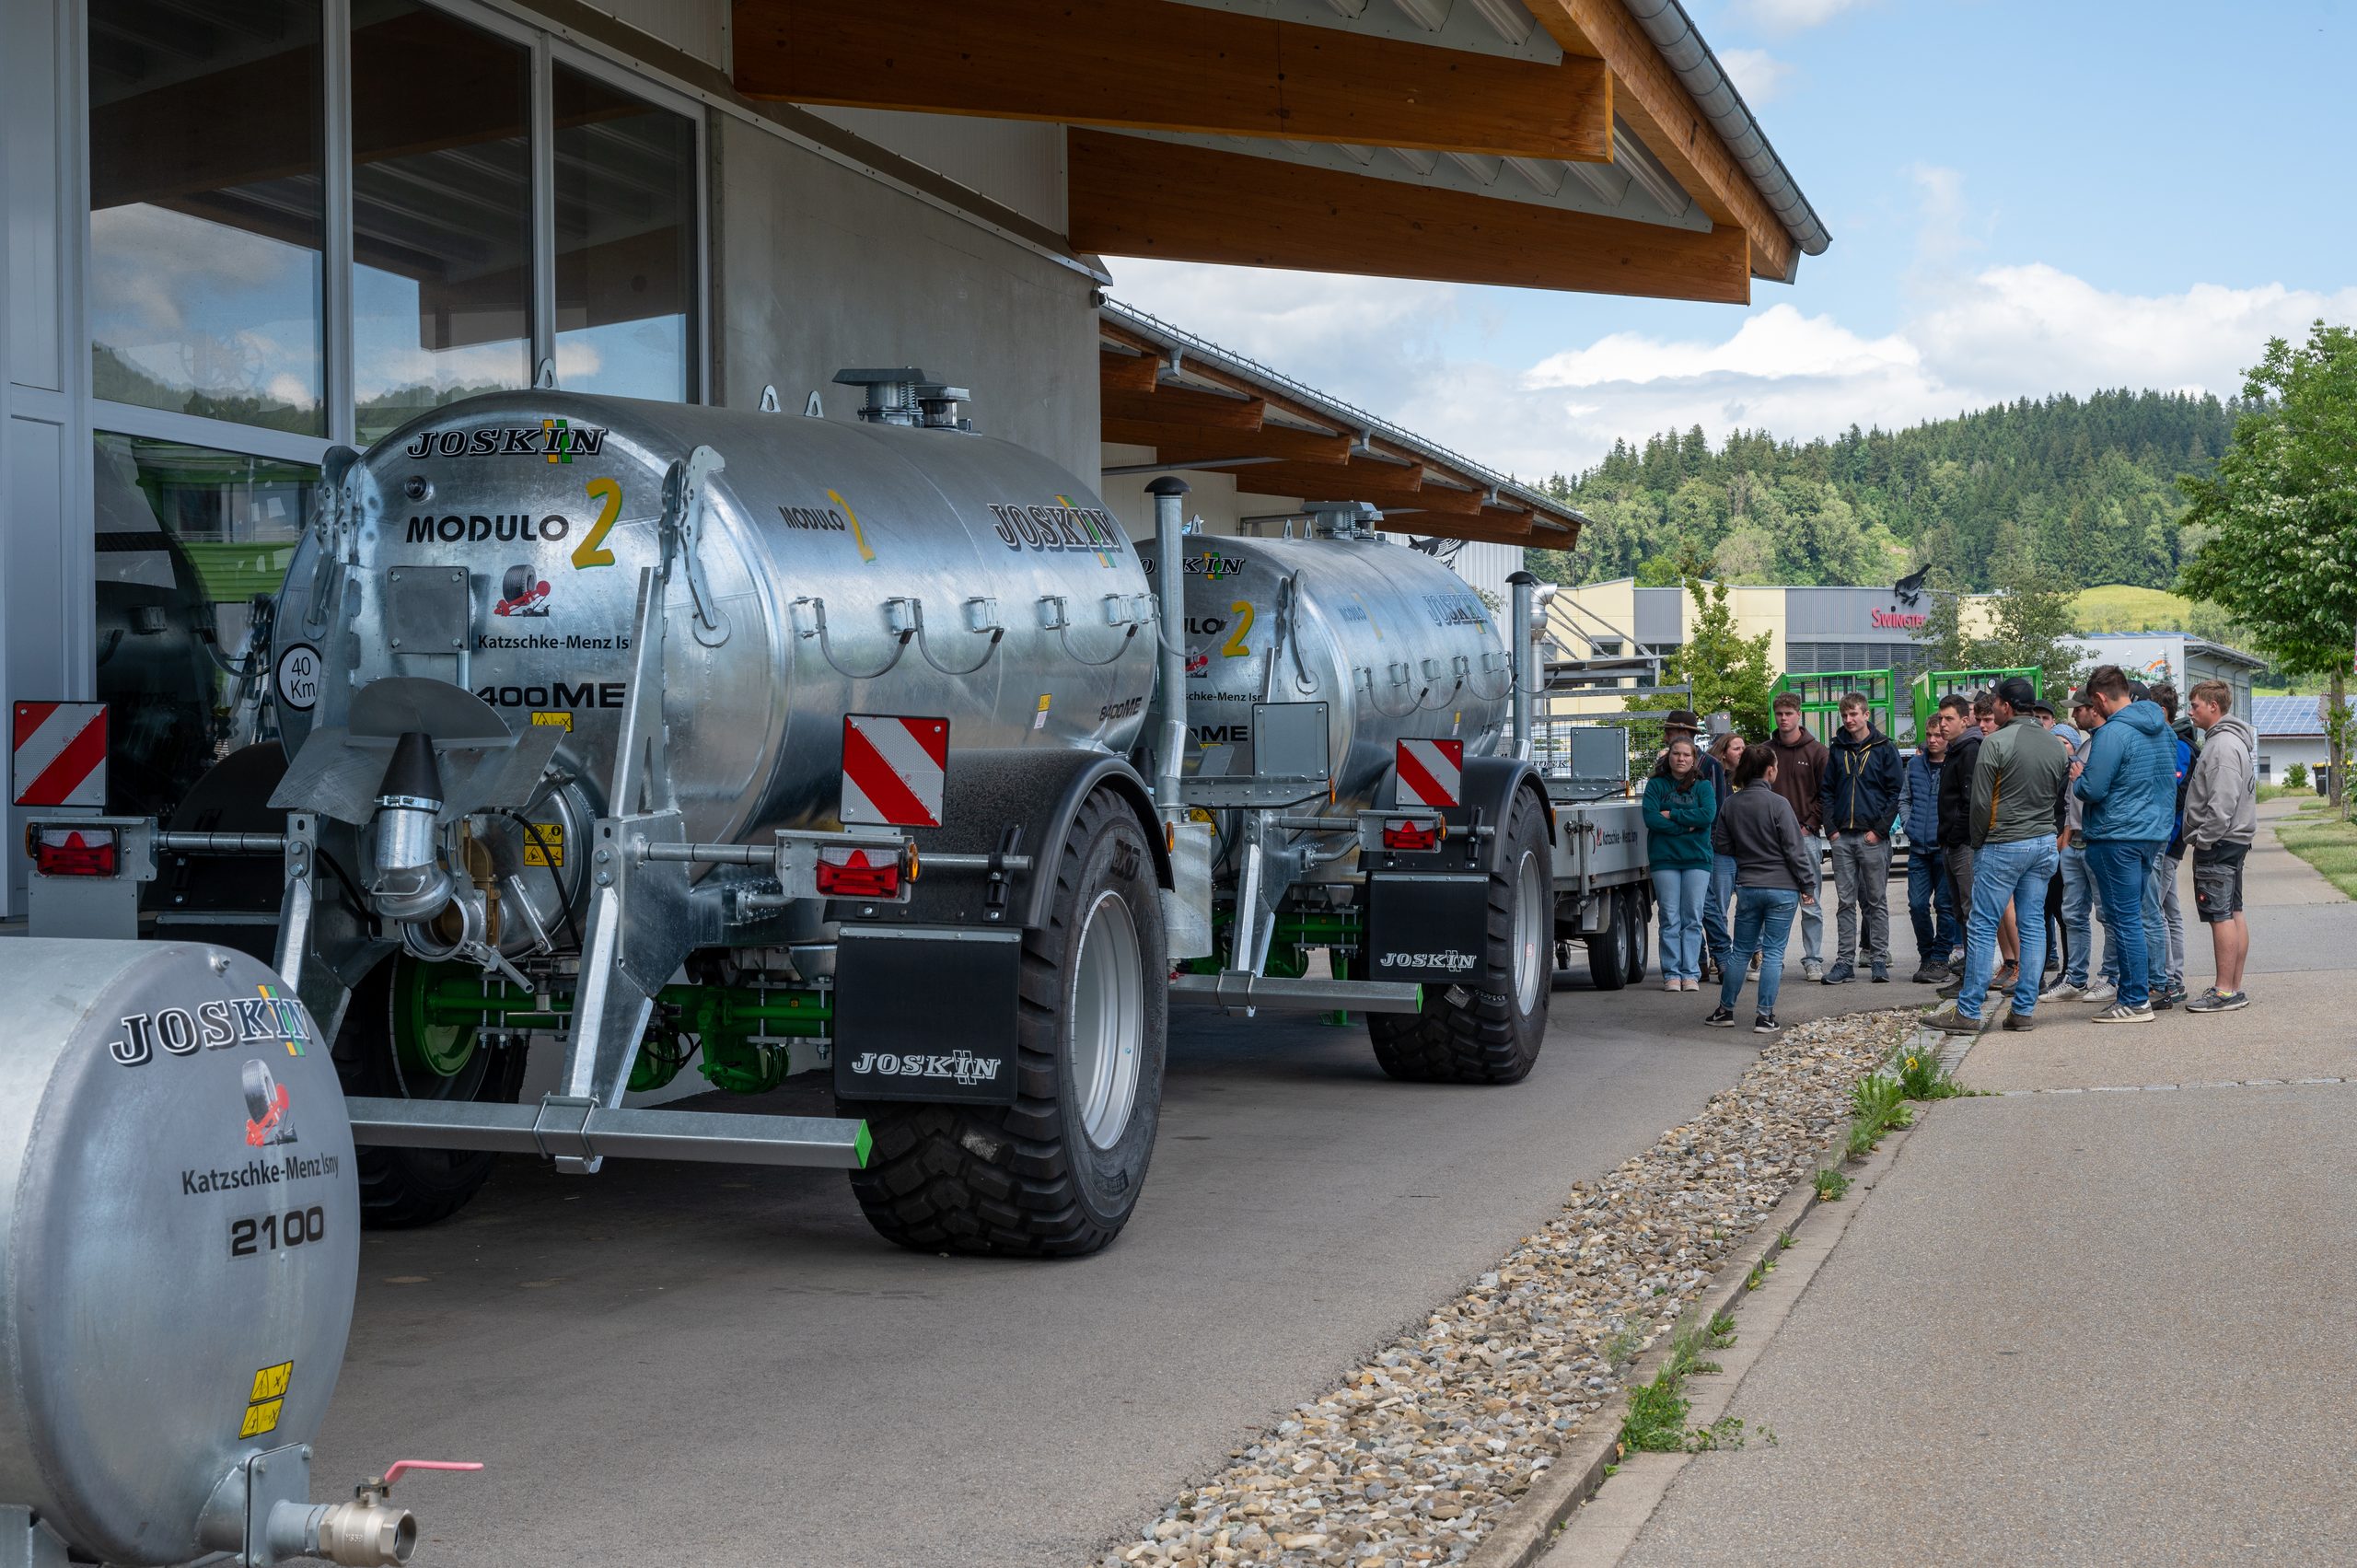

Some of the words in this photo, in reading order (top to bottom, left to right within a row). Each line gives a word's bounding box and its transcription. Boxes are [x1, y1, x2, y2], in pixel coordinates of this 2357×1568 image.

[406, 427, 609, 459] JOSKIN
[405, 515, 570, 543] MODULO
[571, 477, 623, 571] 2
[777, 505, 846, 531] MODULO
[987, 503, 1124, 553] JOSKIN
[478, 634, 612, 650] Katzschke-Menz
[616, 635, 633, 649] Is
[1222, 600, 1255, 658] 2
[291, 656, 311, 677] 40
[290, 679, 316, 700] Km
[470, 682, 627, 708] 400ME
[1380, 952, 1477, 969] JOSKIN
[109, 997, 314, 1067] JOSKIN
[852, 1051, 1001, 1080] JOSKIN
[181, 1156, 322, 1195] Katzschke-Menz
[320, 1152, 339, 1179] Isny
[232, 1205, 323, 1257] 2100
